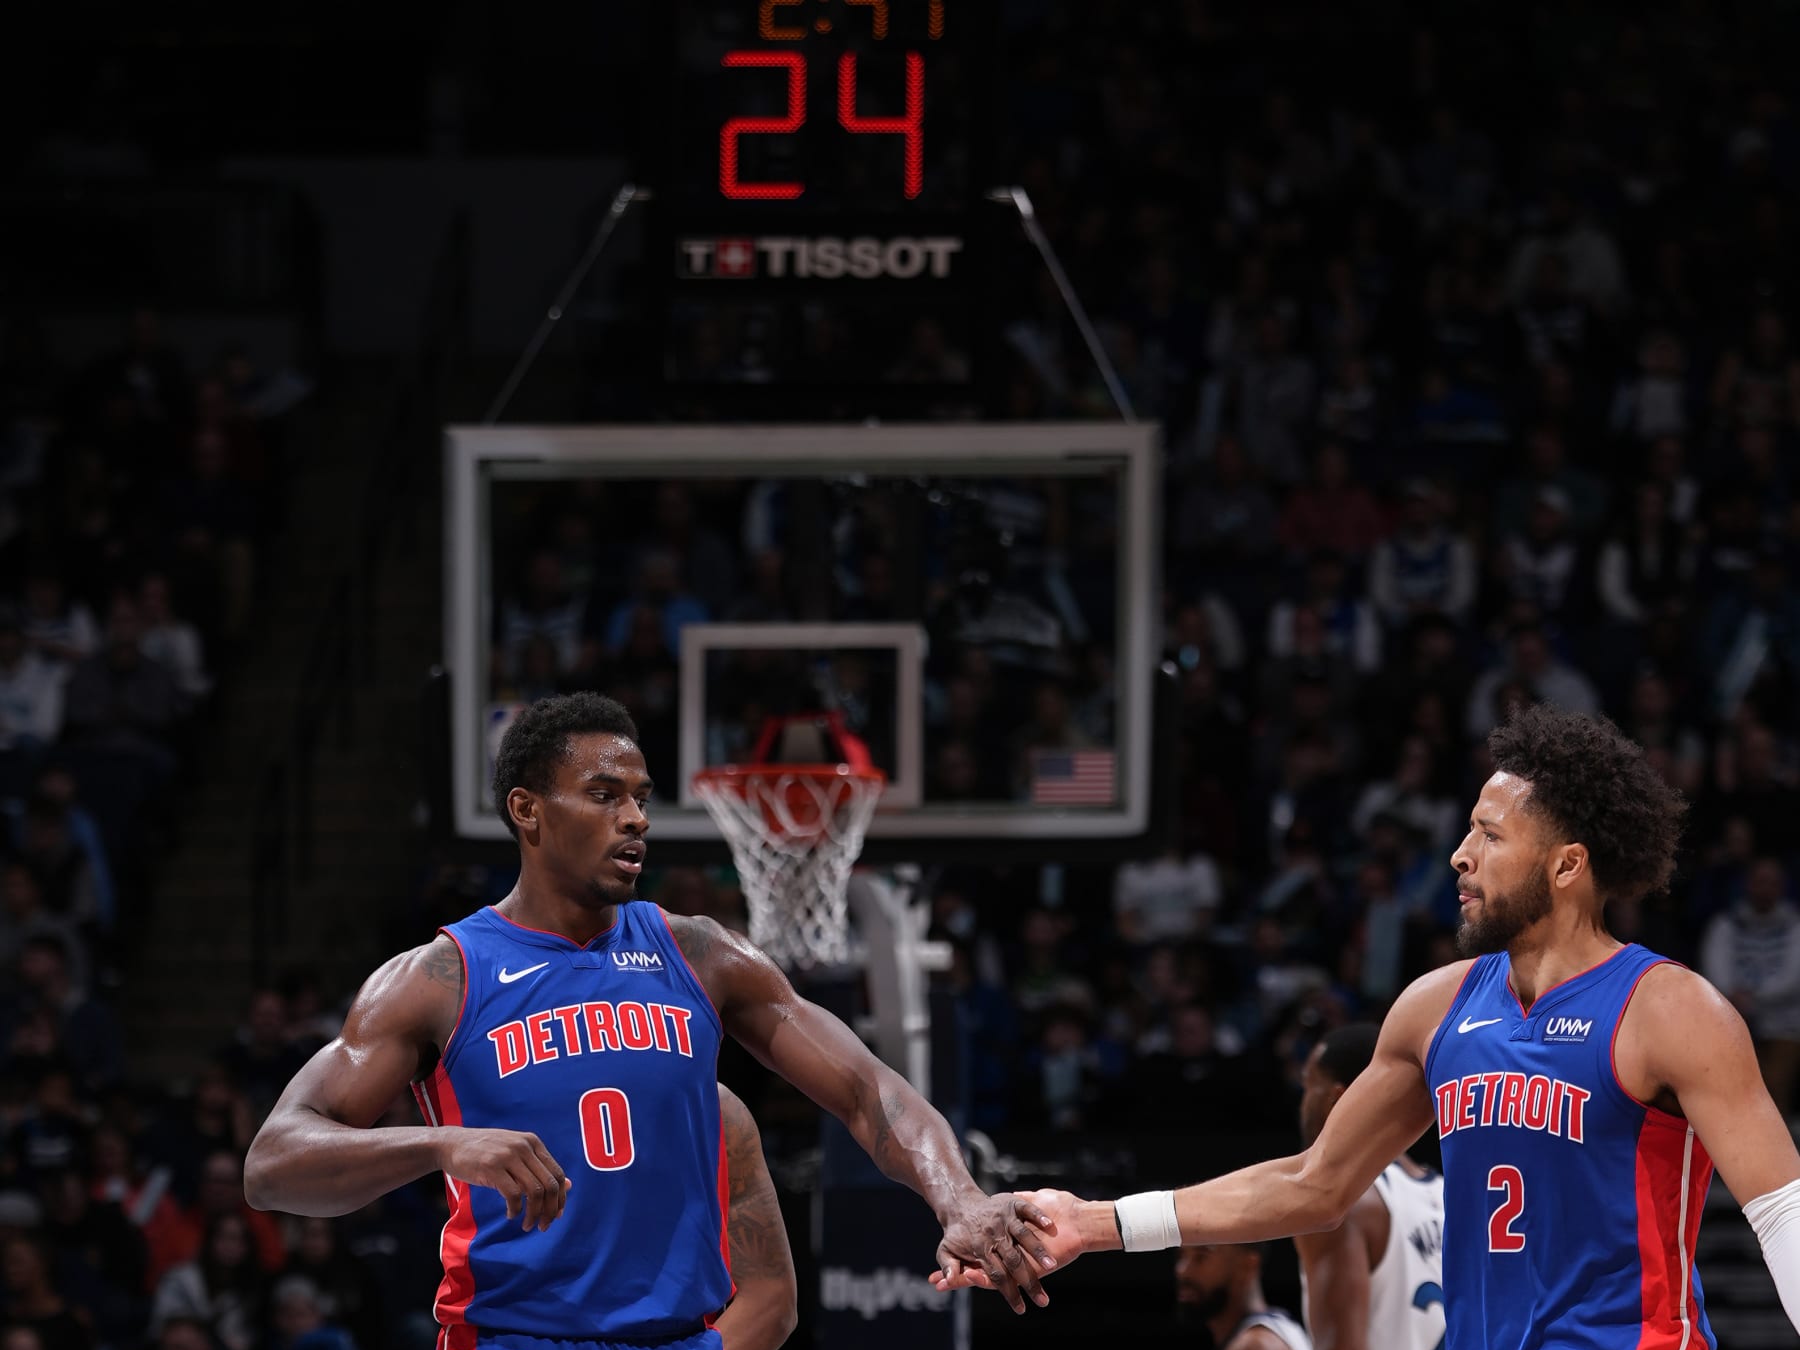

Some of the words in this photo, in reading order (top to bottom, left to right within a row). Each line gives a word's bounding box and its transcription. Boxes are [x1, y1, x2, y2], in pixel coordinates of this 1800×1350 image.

[719, 50, 925, 200] 24
[757, 238, 963, 278] TISSOT
[611, 951, 663, 967] UWM
[487, 1001, 693, 1079] DETROIT
[1545, 1017, 1593, 1037] UWM
[578, 1087, 635, 1172] 0
[1435, 1071, 1591, 1145] DETROIT
[1487, 1164, 1526, 1253] 2
